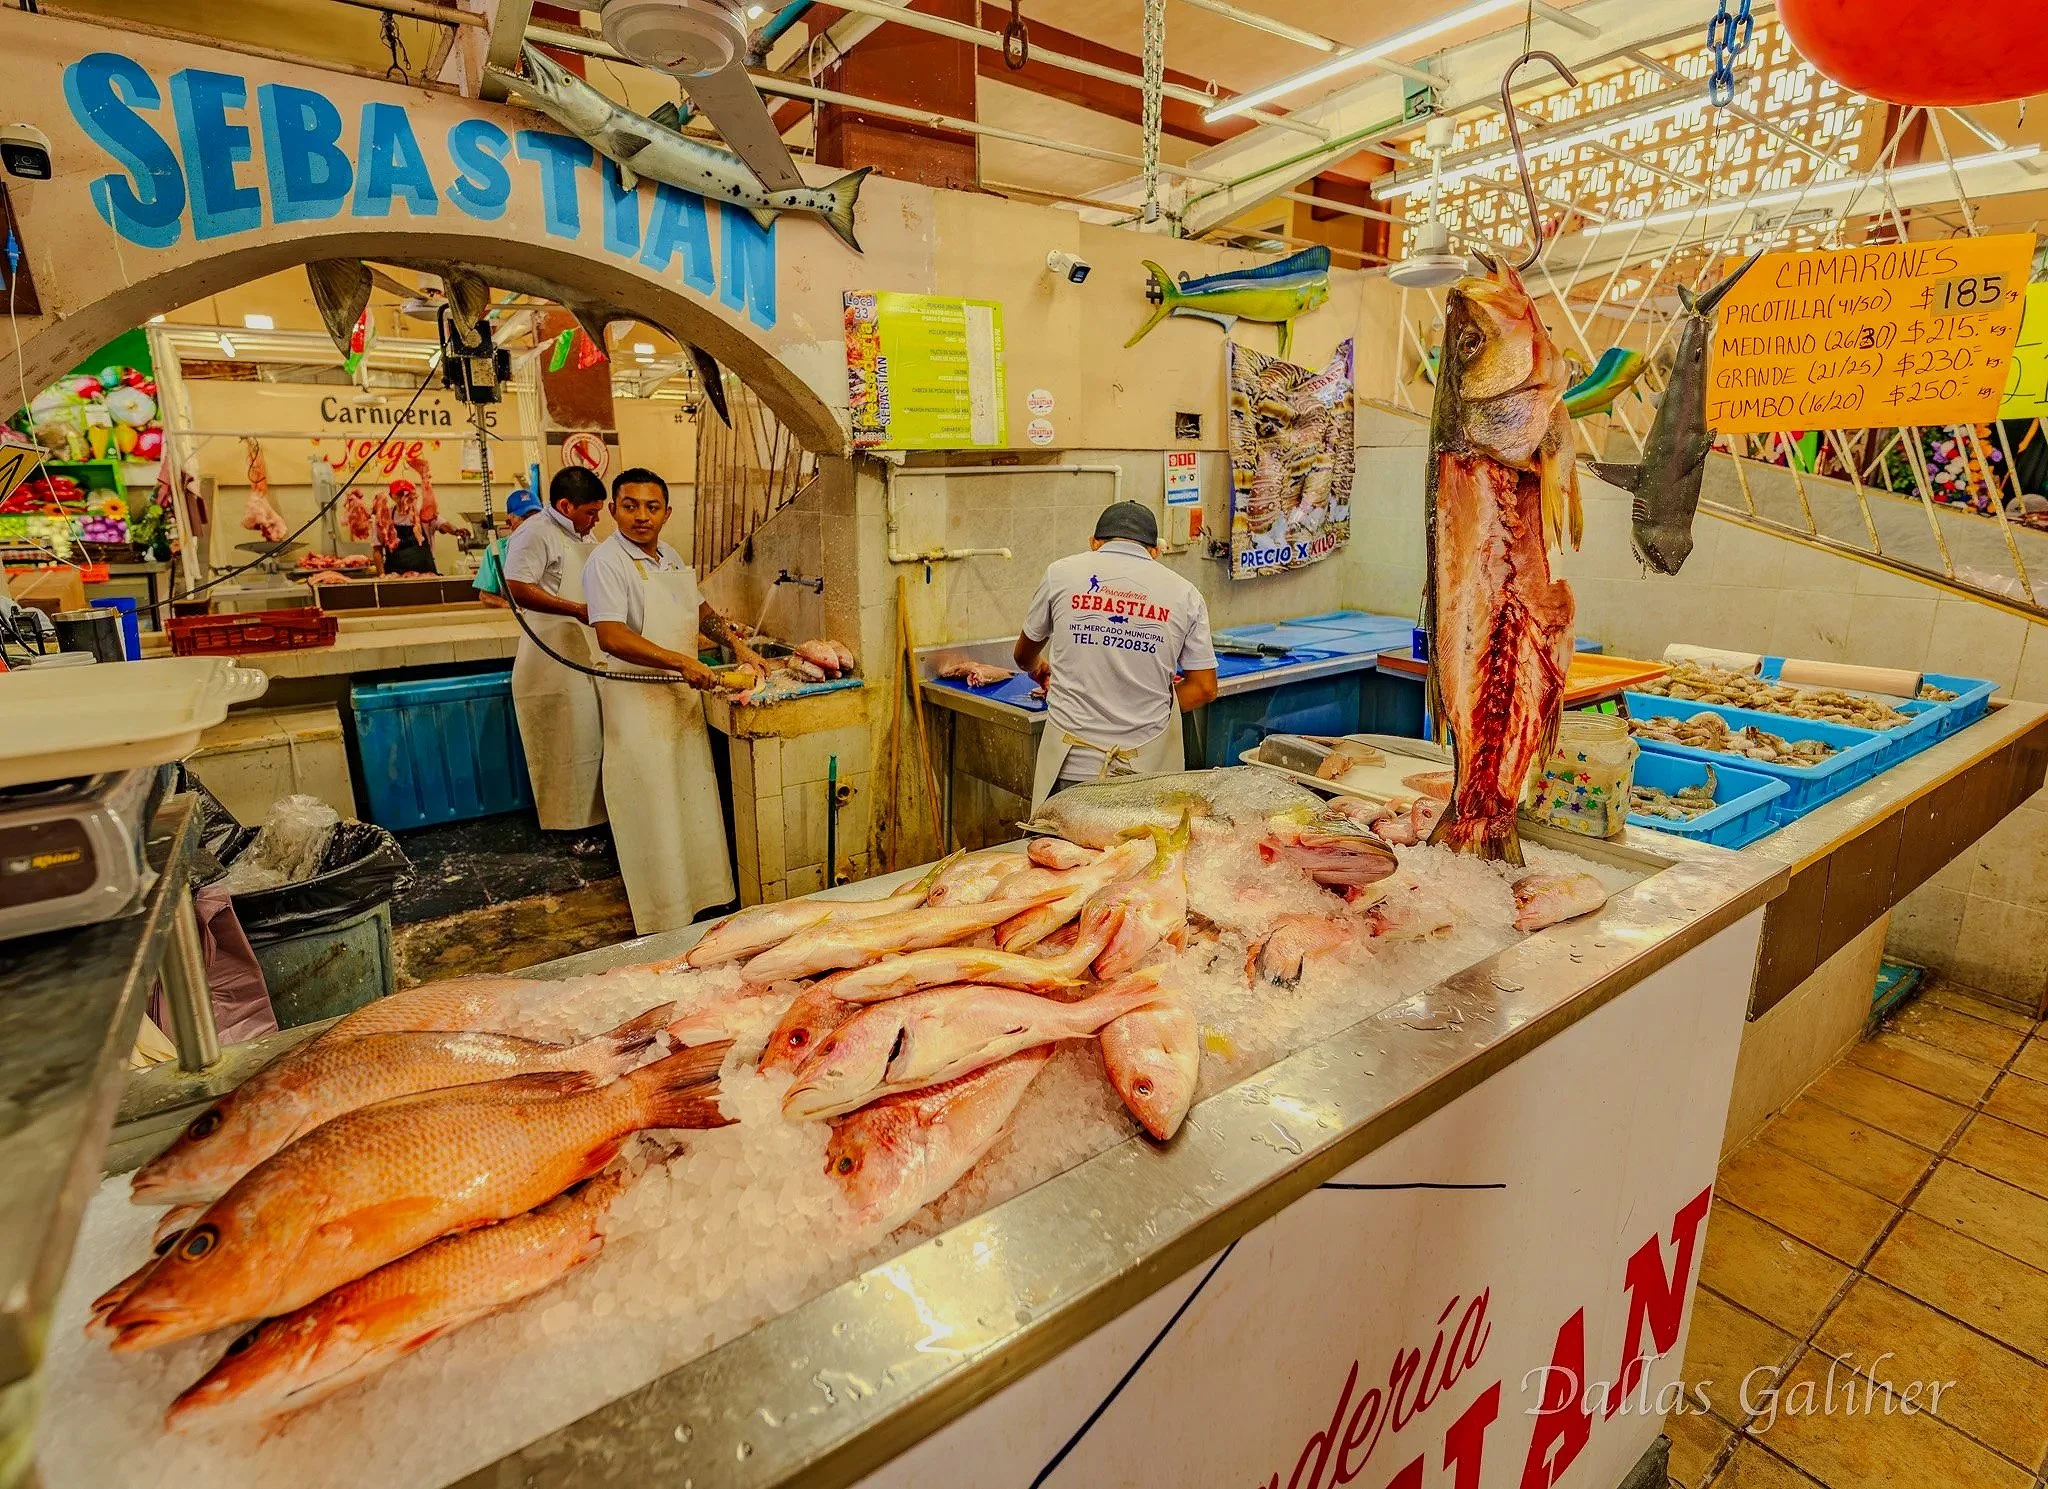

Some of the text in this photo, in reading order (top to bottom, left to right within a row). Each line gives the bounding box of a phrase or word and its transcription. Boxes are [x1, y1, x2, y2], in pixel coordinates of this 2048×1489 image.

[62, 52, 777, 331] SEBASTIAN
[1775, 247, 1959, 289] CAMARONES
[845, 294, 877, 307] Local
[854, 307, 869, 319] 33
[1722, 334, 1816, 357] MEDIANO
[1716, 366, 1798, 389] GRANDE
[877, 356, 892, 426] SEBASTIAN
[1169, 453, 1195, 467] 911
[1240, 534, 1336, 567] PRECIO X KILO
[1072, 594, 1170, 622] SEBASTIAN
[1073, 633, 1156, 654] TEL. 8720836
[1084, 624, 1123, 635] MERCADO
[1125, 630, 1164, 643] MUNICIPAL
